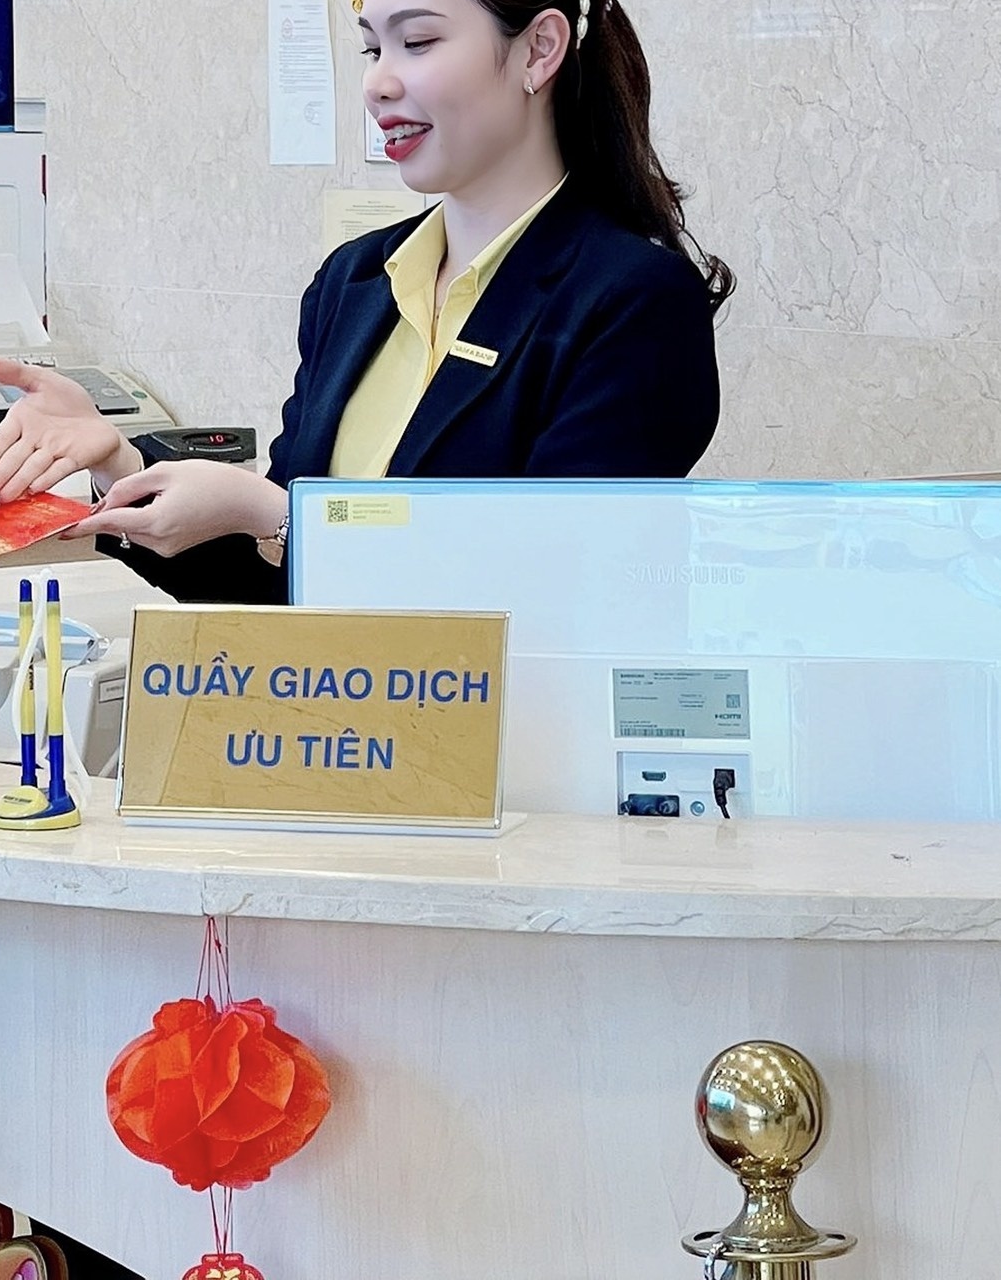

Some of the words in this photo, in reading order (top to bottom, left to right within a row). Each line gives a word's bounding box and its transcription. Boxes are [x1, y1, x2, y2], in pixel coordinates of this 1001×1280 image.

[624, 563, 747, 586] SAMSUNG
[142, 650, 256, 697] QUẦY
[269, 665, 374, 701] GIAO
[387, 668, 490, 709] DỊCH
[226, 729, 283, 768] ƯU
[297, 727, 395, 770] TIÊN
